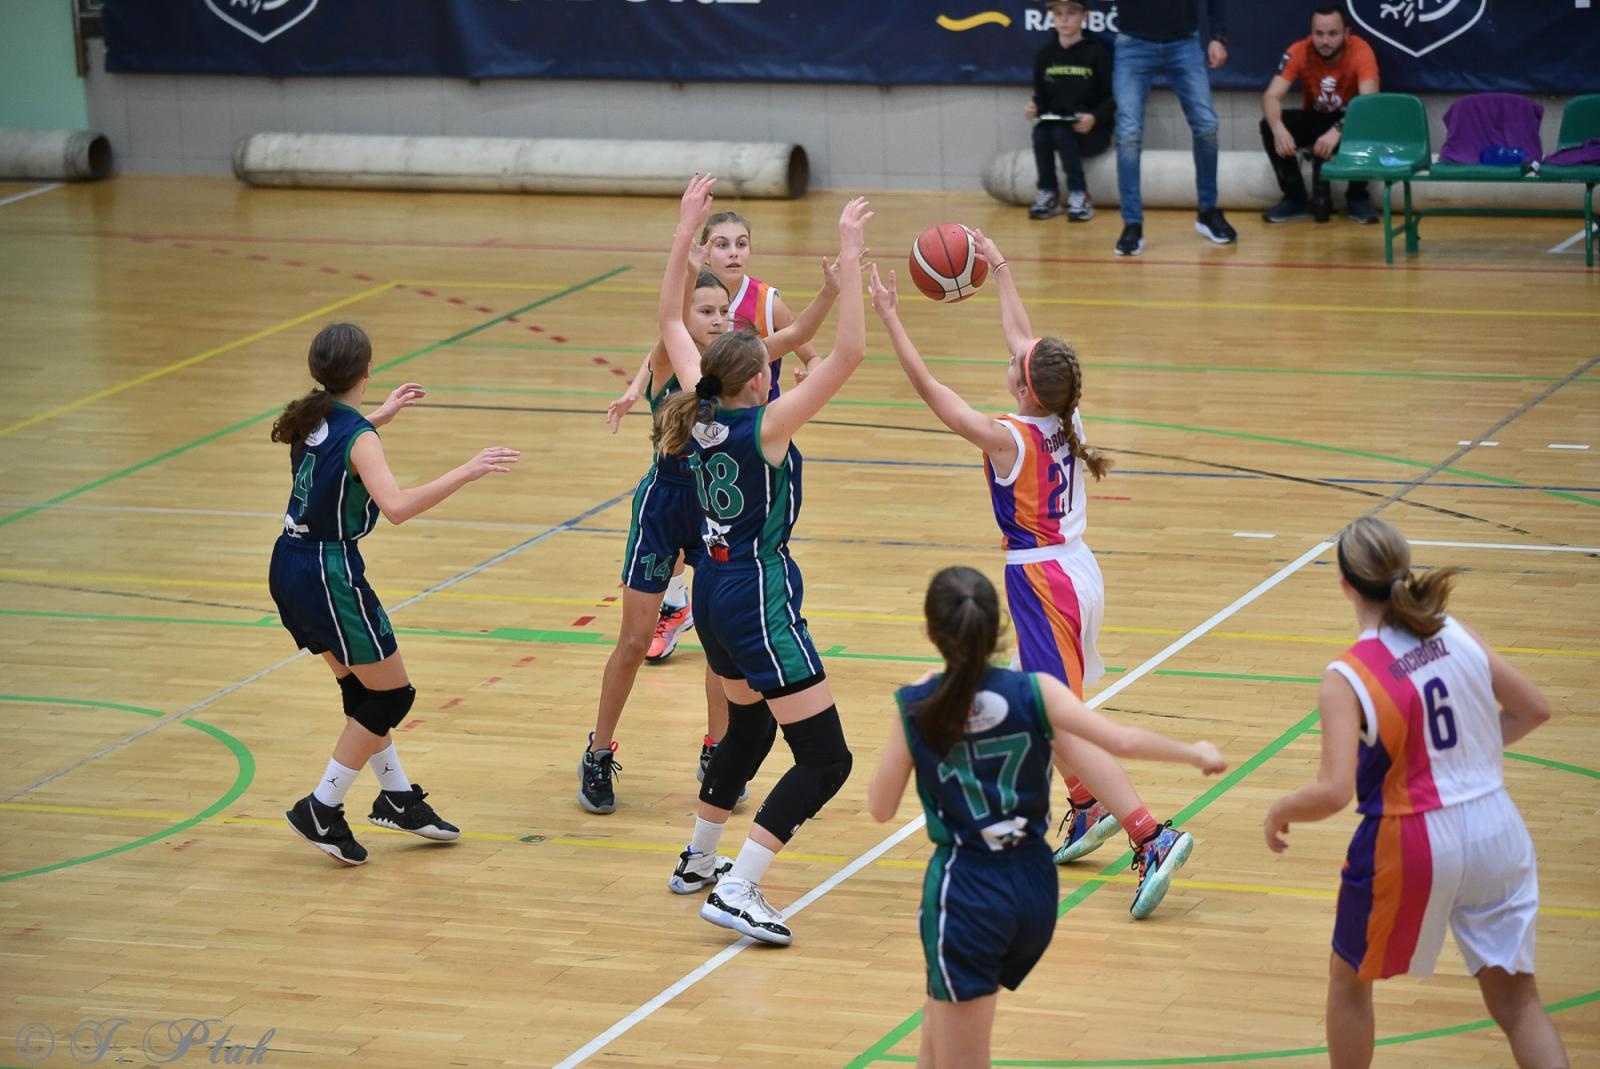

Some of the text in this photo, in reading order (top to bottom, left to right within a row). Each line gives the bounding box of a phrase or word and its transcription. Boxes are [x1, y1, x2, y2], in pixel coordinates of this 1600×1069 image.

[294, 452, 316, 517] 4
[1047, 452, 1076, 520] 27
[640, 552, 673, 581] 14
[1423, 676, 1457, 751] 6
[937, 731, 1032, 821] 17
